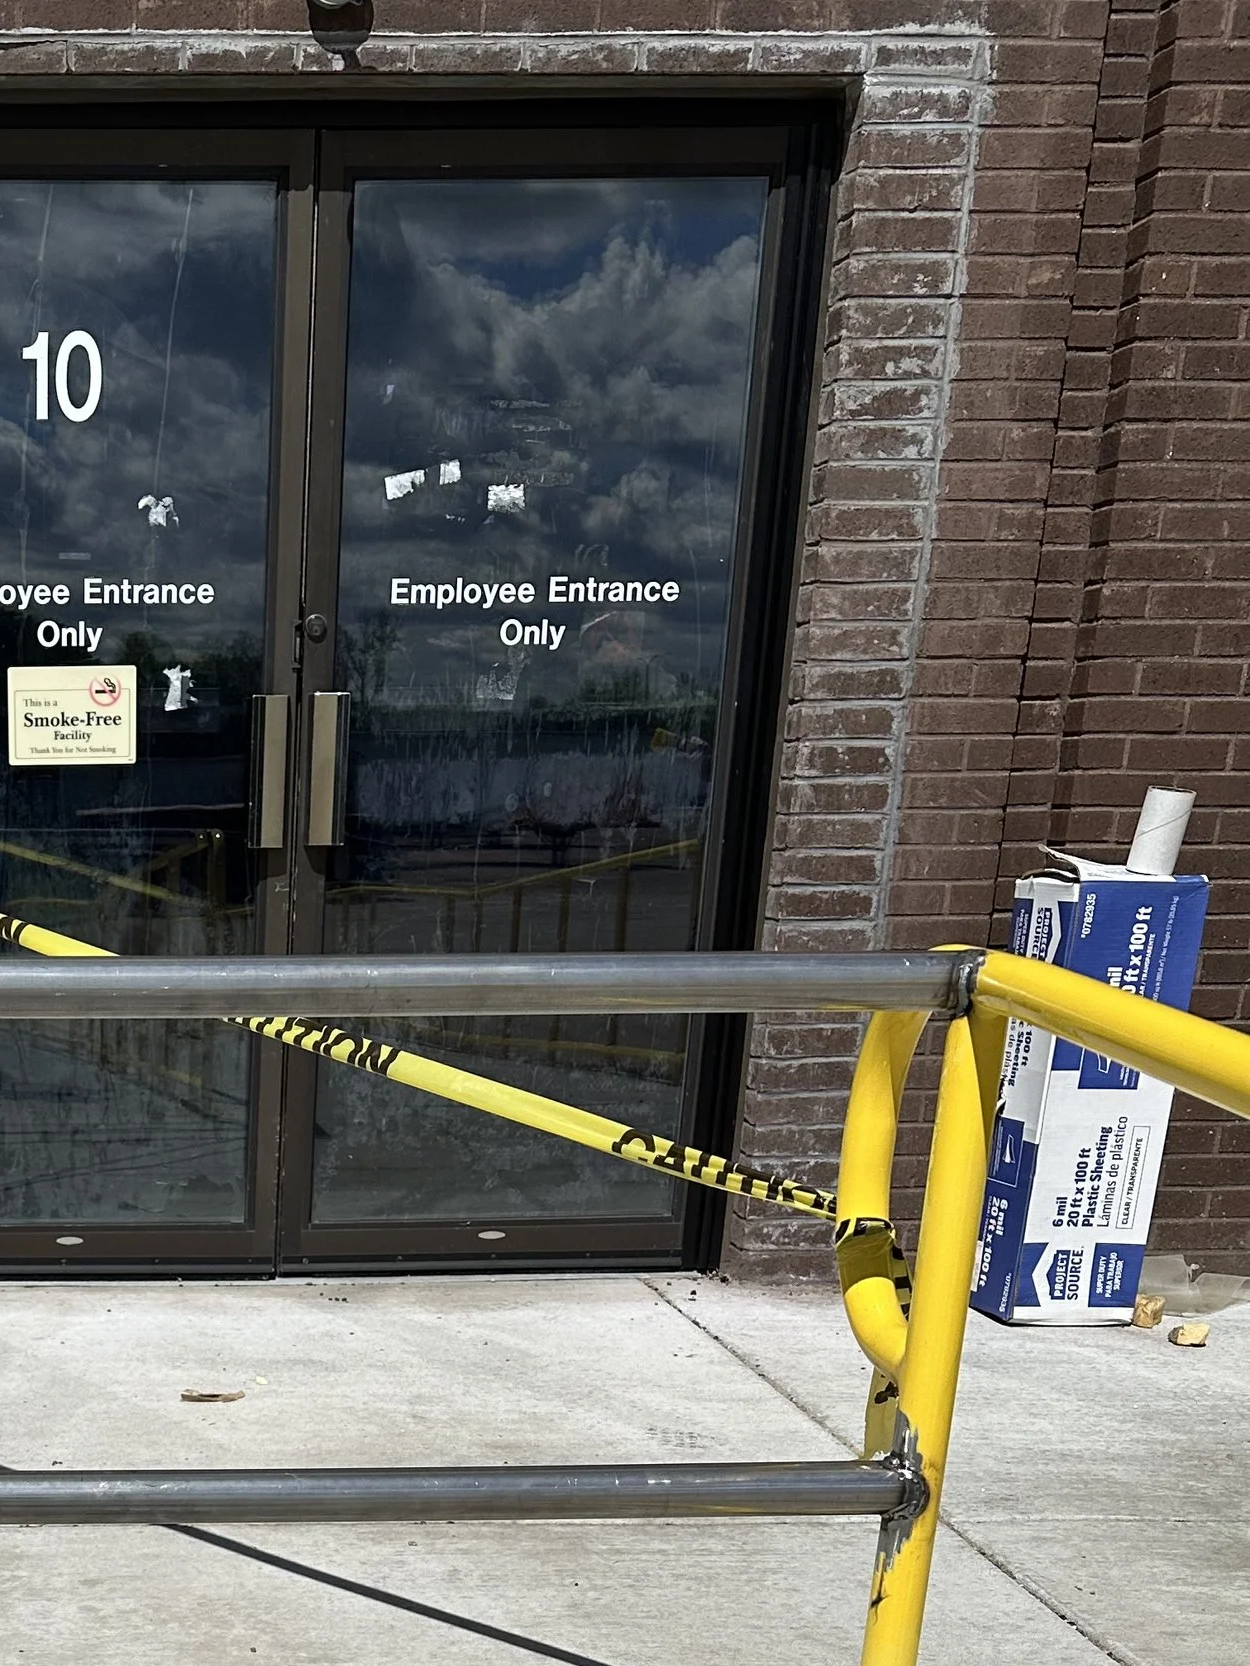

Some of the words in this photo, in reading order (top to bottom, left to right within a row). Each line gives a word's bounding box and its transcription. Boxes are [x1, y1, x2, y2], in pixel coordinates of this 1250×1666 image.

[22, 330, 103, 423] 10
[83, 578, 215, 605] Entrance
[390, 577, 535, 610] Employee
[548, 576, 680, 603] Entrance
[37, 620, 103, 652] Only
[499, 618, 566, 650] Only
[23, 698, 42, 707] This
[44, 698, 51, 707] is
[23, 711, 122, 728] Smoke-Free
[53, 730, 92, 743] Facility
[30, 746, 51, 754] Thank
[52, 746, 64, 754] You
[88, 745, 117, 754] Smoking
[1135, 906, 1153, 921] ft
[1039, 911, 1051, 958] PROJECT
[1129, 922, 1149, 953] 100
[1130, 954, 1143, 967] x
[1141, 933, 1156, 981] TRANSPARENTE
[1123, 968, 1140, 983] ft
[227, 1016, 402, 1076] UTION
[1007, 1034, 1016, 1048] de
[1023, 1029, 1033, 1054] 100
[1008, 1031, 1024, 1087] Sheeting
[1020, 1055, 1029, 1067] ft
[1109, 1116, 1128, 1161] plástico
[1078, 1147, 1091, 1158] ft
[1090, 1126, 1113, 1182] Sheeting
[1074, 1161, 1089, 1185] 100
[1105, 1163, 1120, 1178] de
[1075, 1186, 1085, 1196] x
[1121, 1203, 1131, 1225] CLEAR
[1126, 1137, 1143, 1196] TRANSPARENTE
[990, 1196, 1000, 1217] 20
[1000, 1199, 1008, 1210] 6
[1055, 1196, 1068, 1216] mil
[1070, 1196, 1083, 1208] ft
[1081, 1184, 1100, 1228] Plastic
[1096, 1180, 1117, 1228] Láminas
[987, 1218, 997, 1232] ft
[995, 1211, 1005, 1236] mil
[1052, 1218, 1064, 1228] 6
[1066, 1210, 1080, 1228] 20
[986, 1233, 993, 1244] x
[981, 1246, 992, 1273] 100
[1098, 1255, 1107, 1273] DUTY
[978, 1274, 988, 1288] ft
[1053, 1253, 1068, 1297] PROJECT
[1067, 1249, 1085, 1301] SOURCE
[1096, 1274, 1105, 1294] SUPER
[1105, 1280, 1114, 1298] PARA
